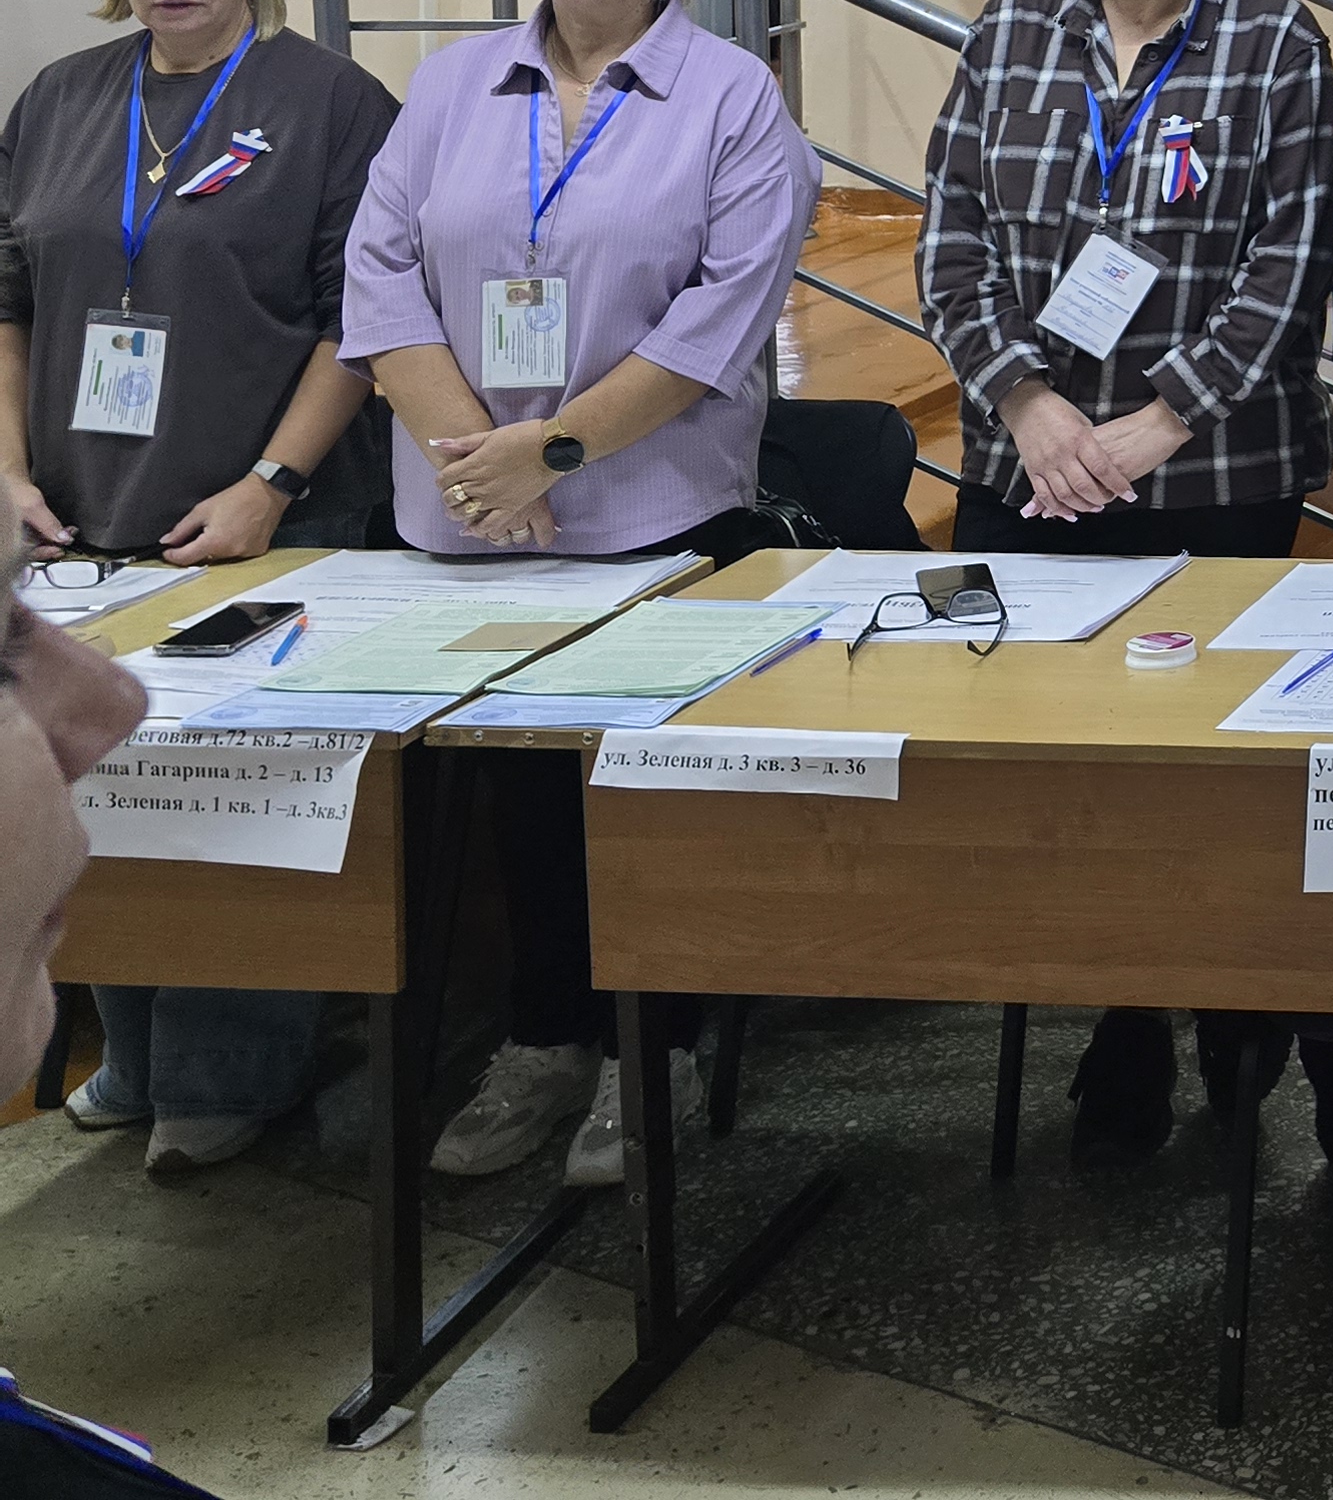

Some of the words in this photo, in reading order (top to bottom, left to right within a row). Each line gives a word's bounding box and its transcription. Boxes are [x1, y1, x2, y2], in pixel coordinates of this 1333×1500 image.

[125, 730, 203, 748] реговая
[206, 730, 247, 747] д.72
[252, 731, 292, 747] кв.2
[90, 763, 130, 778] ица
[136, 760, 230, 782] Гагарина
[234, 764, 252, 781] д.
[258, 764, 268, 780] 2
[290, 768, 307, 783] д.
[314, 766, 333, 783] 13
[600, 751, 631, 770] ул.
[637, 749, 713, 770] Зеленая
[717, 758, 734, 772] д.
[738, 755, 749, 770] 3
[756, 759, 785, 772] кв.
[790, 756, 801, 772] 3
[822, 761, 839, 775] д.
[844, 758, 866, 775] 36
[106, 791, 183, 811] Зеленая
[188, 797, 205, 813] д.
[212, 796, 220, 812] 1
[228, 801, 256, 814] кв.
[263, 798, 271, 815] 1
